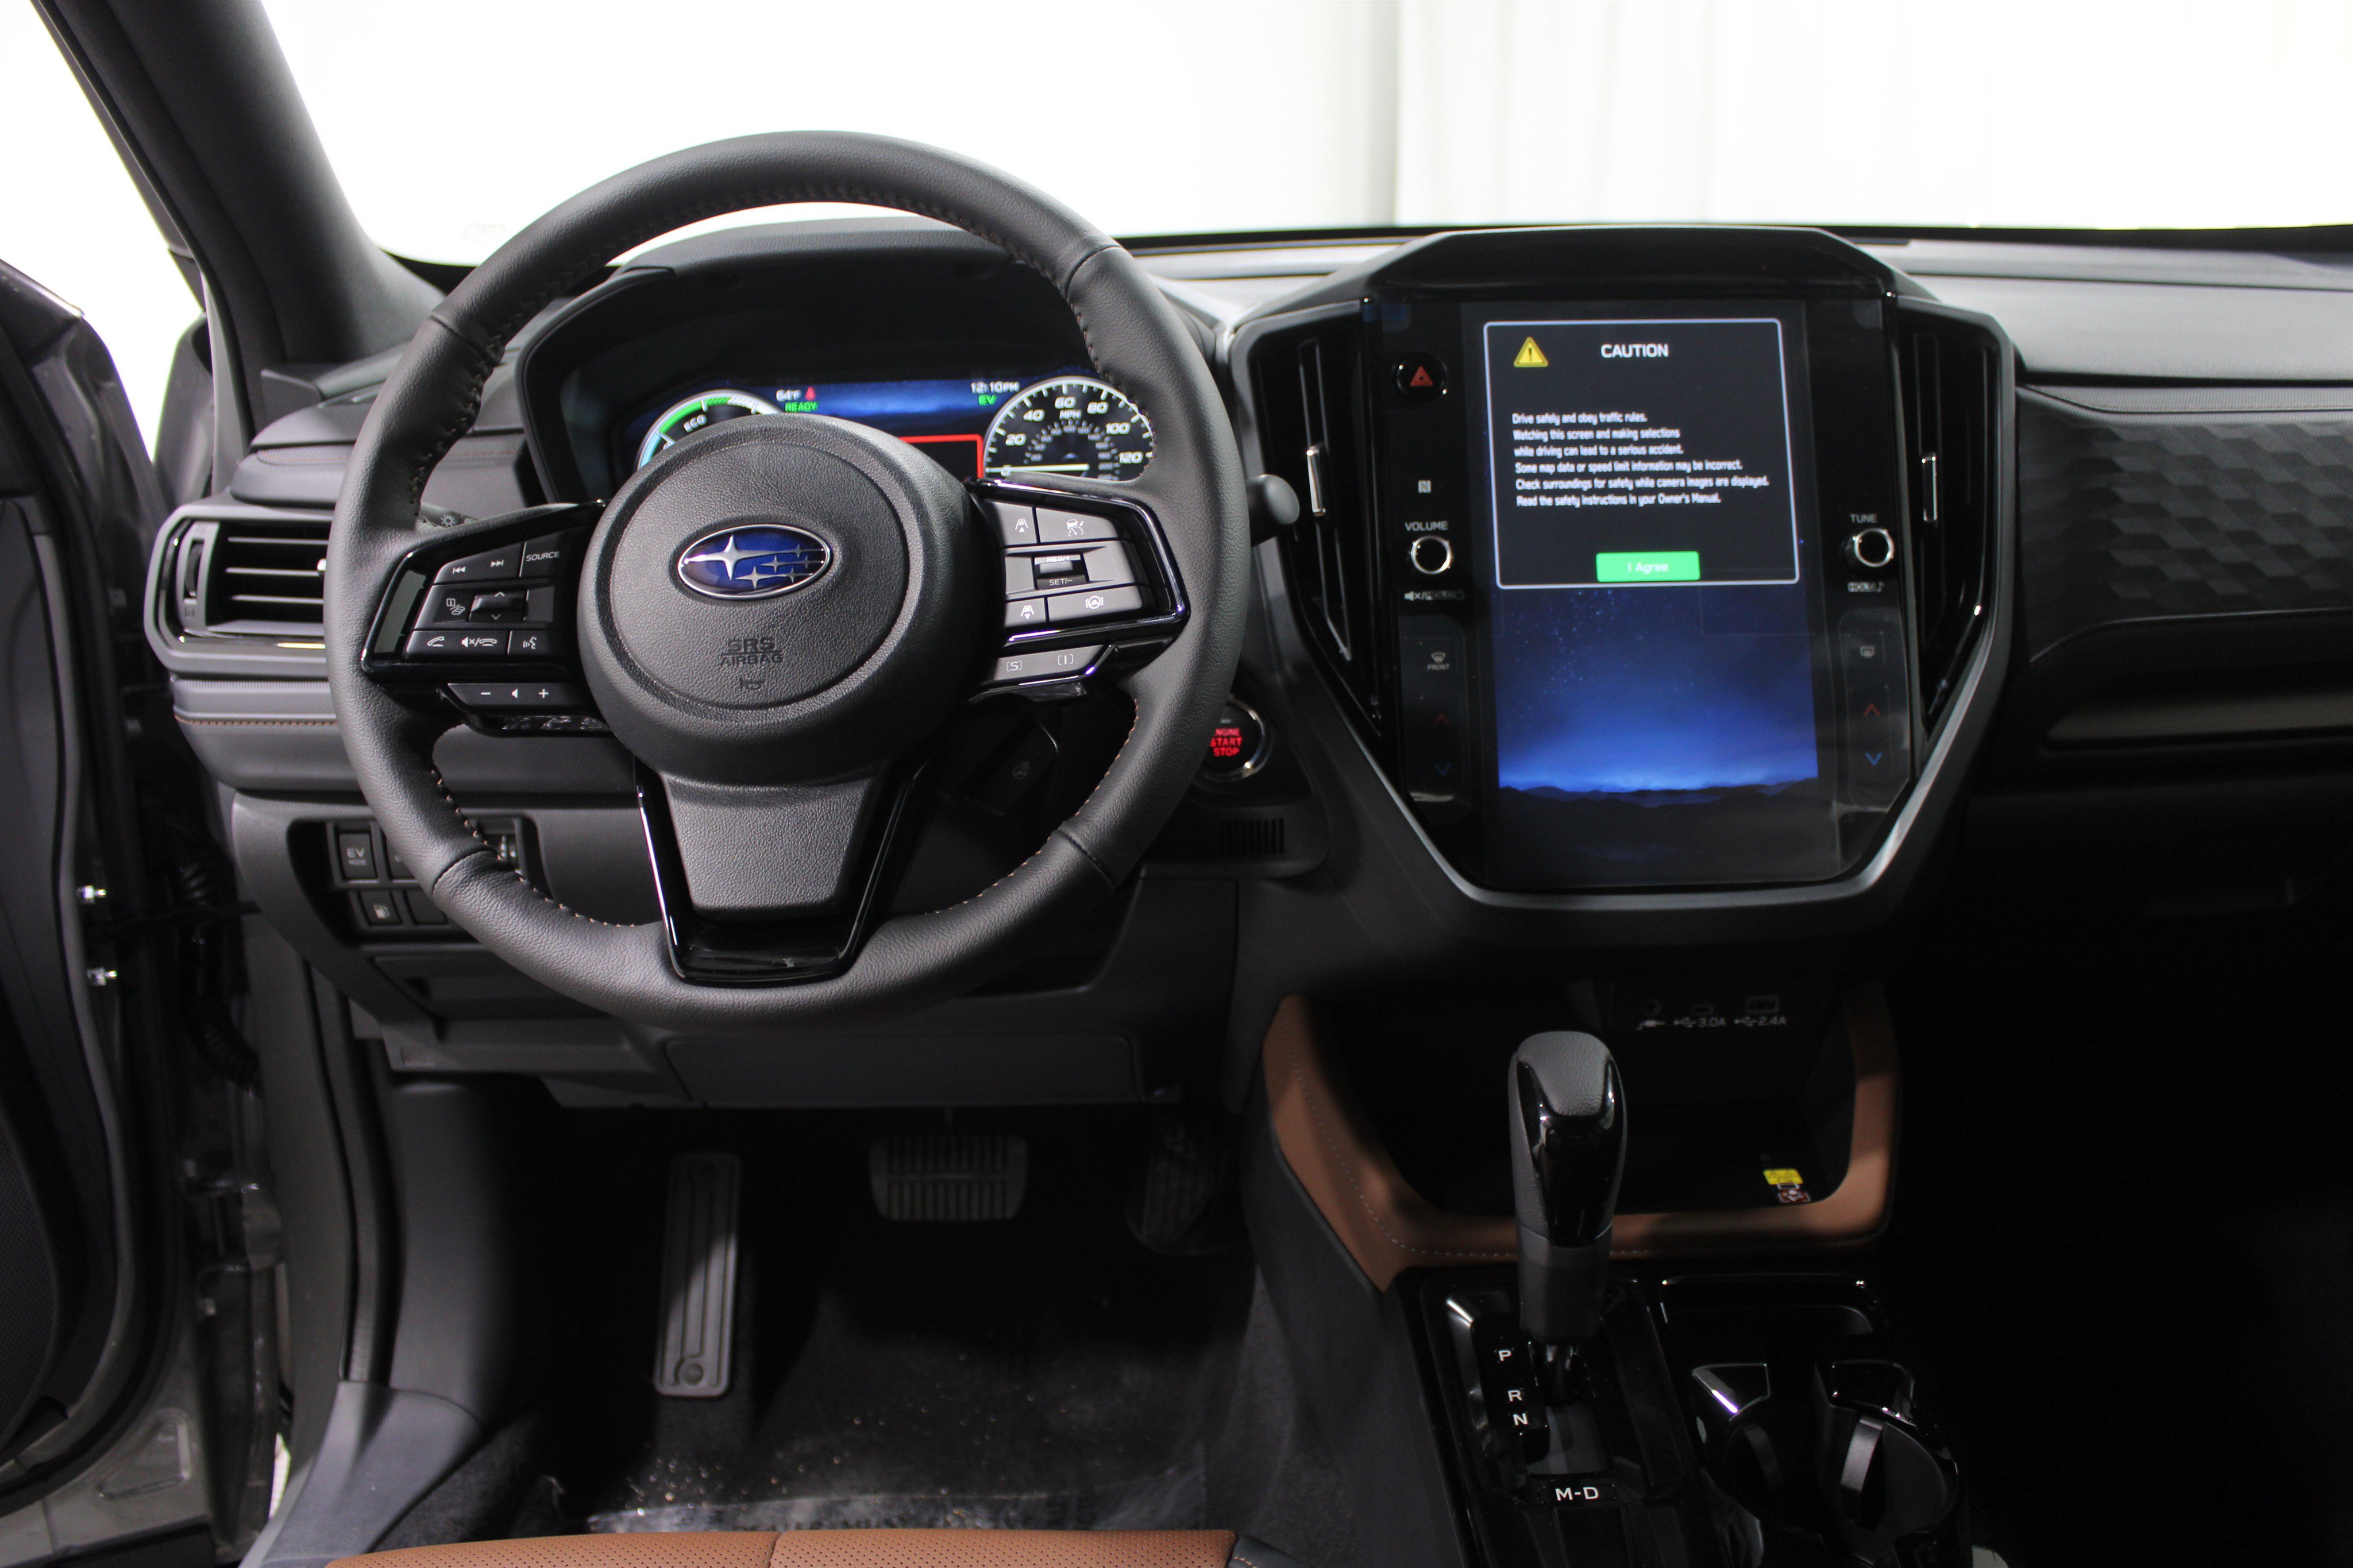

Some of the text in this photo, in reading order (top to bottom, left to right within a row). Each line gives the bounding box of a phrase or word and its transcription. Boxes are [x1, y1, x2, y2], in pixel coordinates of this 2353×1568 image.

[1601, 343, 1669, 358] CAUTION
[978, 395, 997, 405] EV
[1055, 396, 1076, 409] 60
[785, 401, 818, 412] READY
[1087, 401, 1109, 414] 80
[1023, 410, 1045, 422] 40
[1059, 410, 1082, 419] MPH
[1512, 413, 1534, 424] Drive
[1561, 412, 1576, 423] and
[1577, 412, 1598, 425] obey
[1599, 411, 1623, 423] traffic
[1625, 411, 1648, 422] rules.
[683, 414, 707, 432] ECO
[1106, 422, 1131, 434] 100
[1005, 434, 1027, 446] 20
[1513, 427, 1680, 442] Watching this screen and making selections
[1514, 443, 1684, 458] while driving can lead to a serious accident.
[1119, 451, 1143, 464] 120
[1515, 459, 1742, 474] Some map data or speed limit information may be incorrect.
[1515, 475, 1769, 491] Check surroundings for safety while camera images are displayed.
[1516, 492, 1722, 508] Read the safety instructions in your Owner's Manual.
[1850, 513, 1877, 523] TUNE
[1405, 522, 1448, 531] VOLUME
[526, 551, 560, 562] SOURCE
[1627, 562, 1669, 575] I Agree
[728, 637, 776, 653] SRS
[722, 654, 784, 666] AIRBAG
[1427, 663, 1450, 671] FRONT
[1215, 728, 1240, 736] NGINE
[1210, 737, 1243, 747] START
[1213, 748, 1240, 756] STOP
[346, 848, 365, 858] EV
[1698, 1016, 1787, 1028] 3.0A 2.4A
[1498, 1350, 1511, 1361] P
[1507, 1389, 1522, 1401] R
[1513, 1412, 1528, 1426] N
